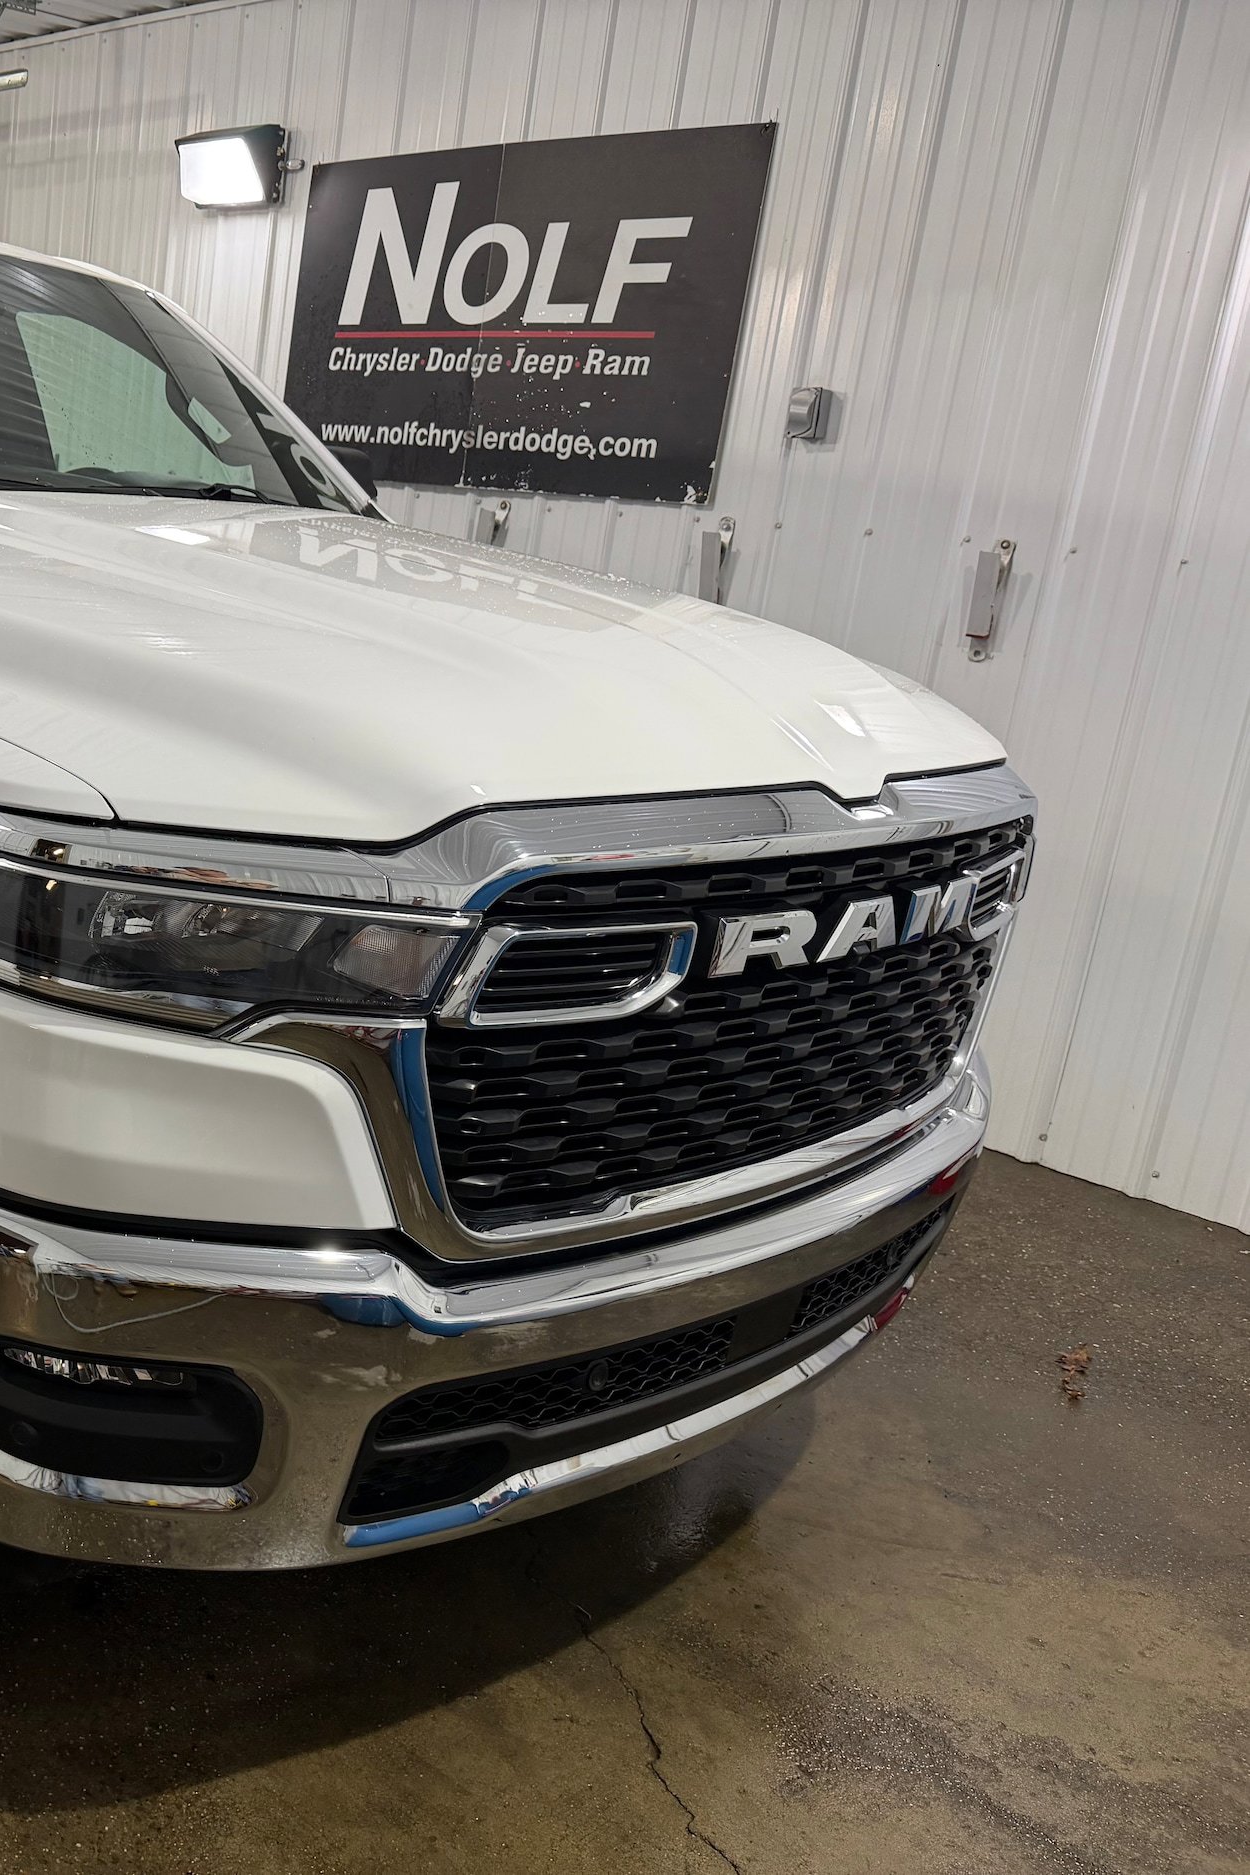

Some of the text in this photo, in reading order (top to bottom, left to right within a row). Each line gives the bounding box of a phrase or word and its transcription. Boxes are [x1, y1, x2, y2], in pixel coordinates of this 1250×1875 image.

[337, 180, 694, 326] NOLF
[328, 346, 651, 380] Chrysler Dodge Jeep Ram
[320, 420, 658, 460] www.nolfchryslerdodge.com
[707, 875, 974, 979] RAM
